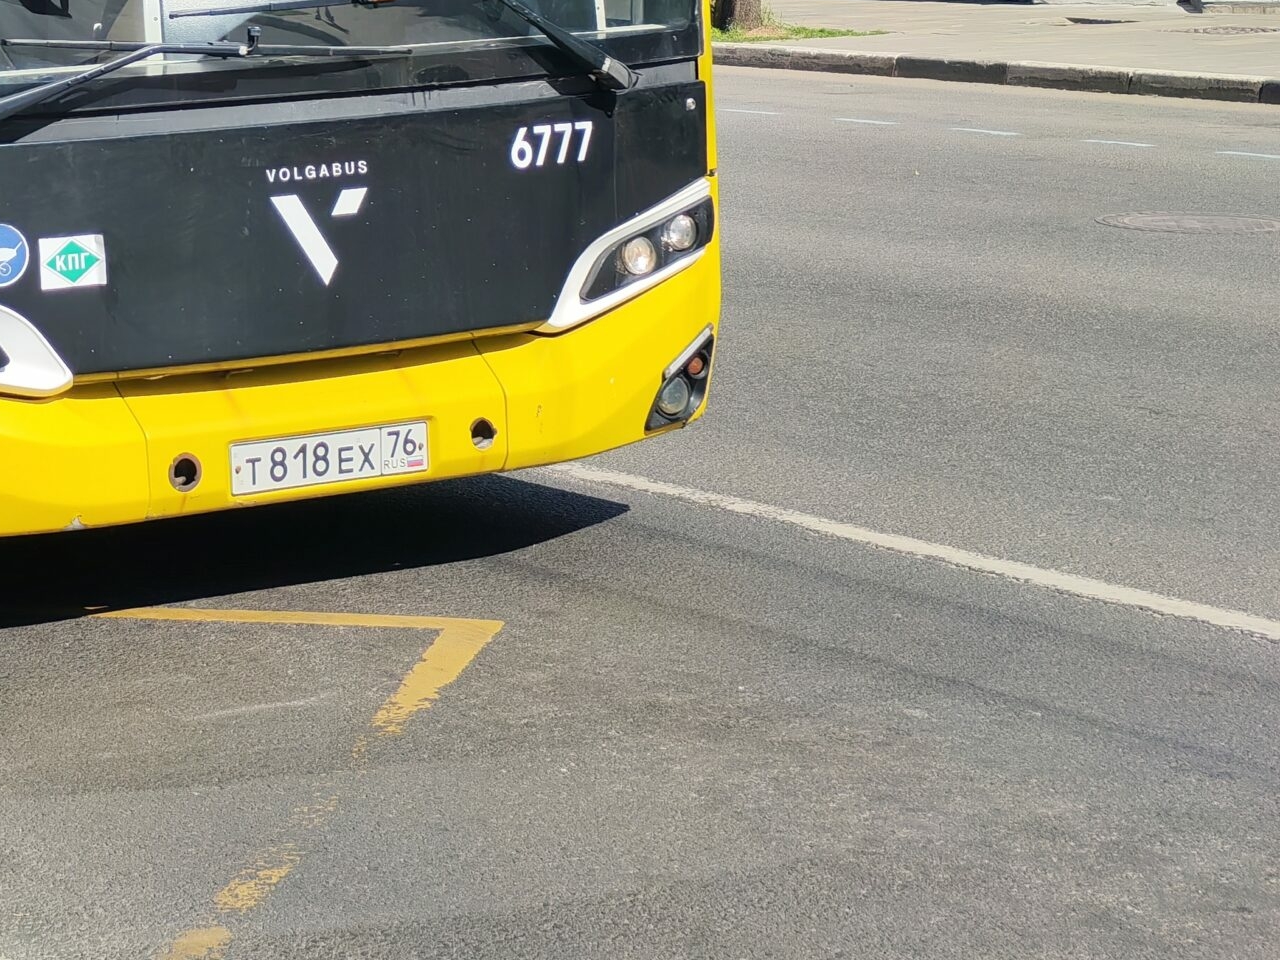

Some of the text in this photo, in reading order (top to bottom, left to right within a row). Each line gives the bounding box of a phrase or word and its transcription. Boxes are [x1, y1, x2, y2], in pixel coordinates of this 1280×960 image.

[511, 120, 594, 169] 6777
[265, 159, 369, 183] VOLGABUS
[55, 252, 91, 272] КПГ
[245, 428, 417, 486] Т818ЕХ 76
[383, 456, 406, 469] RUS
